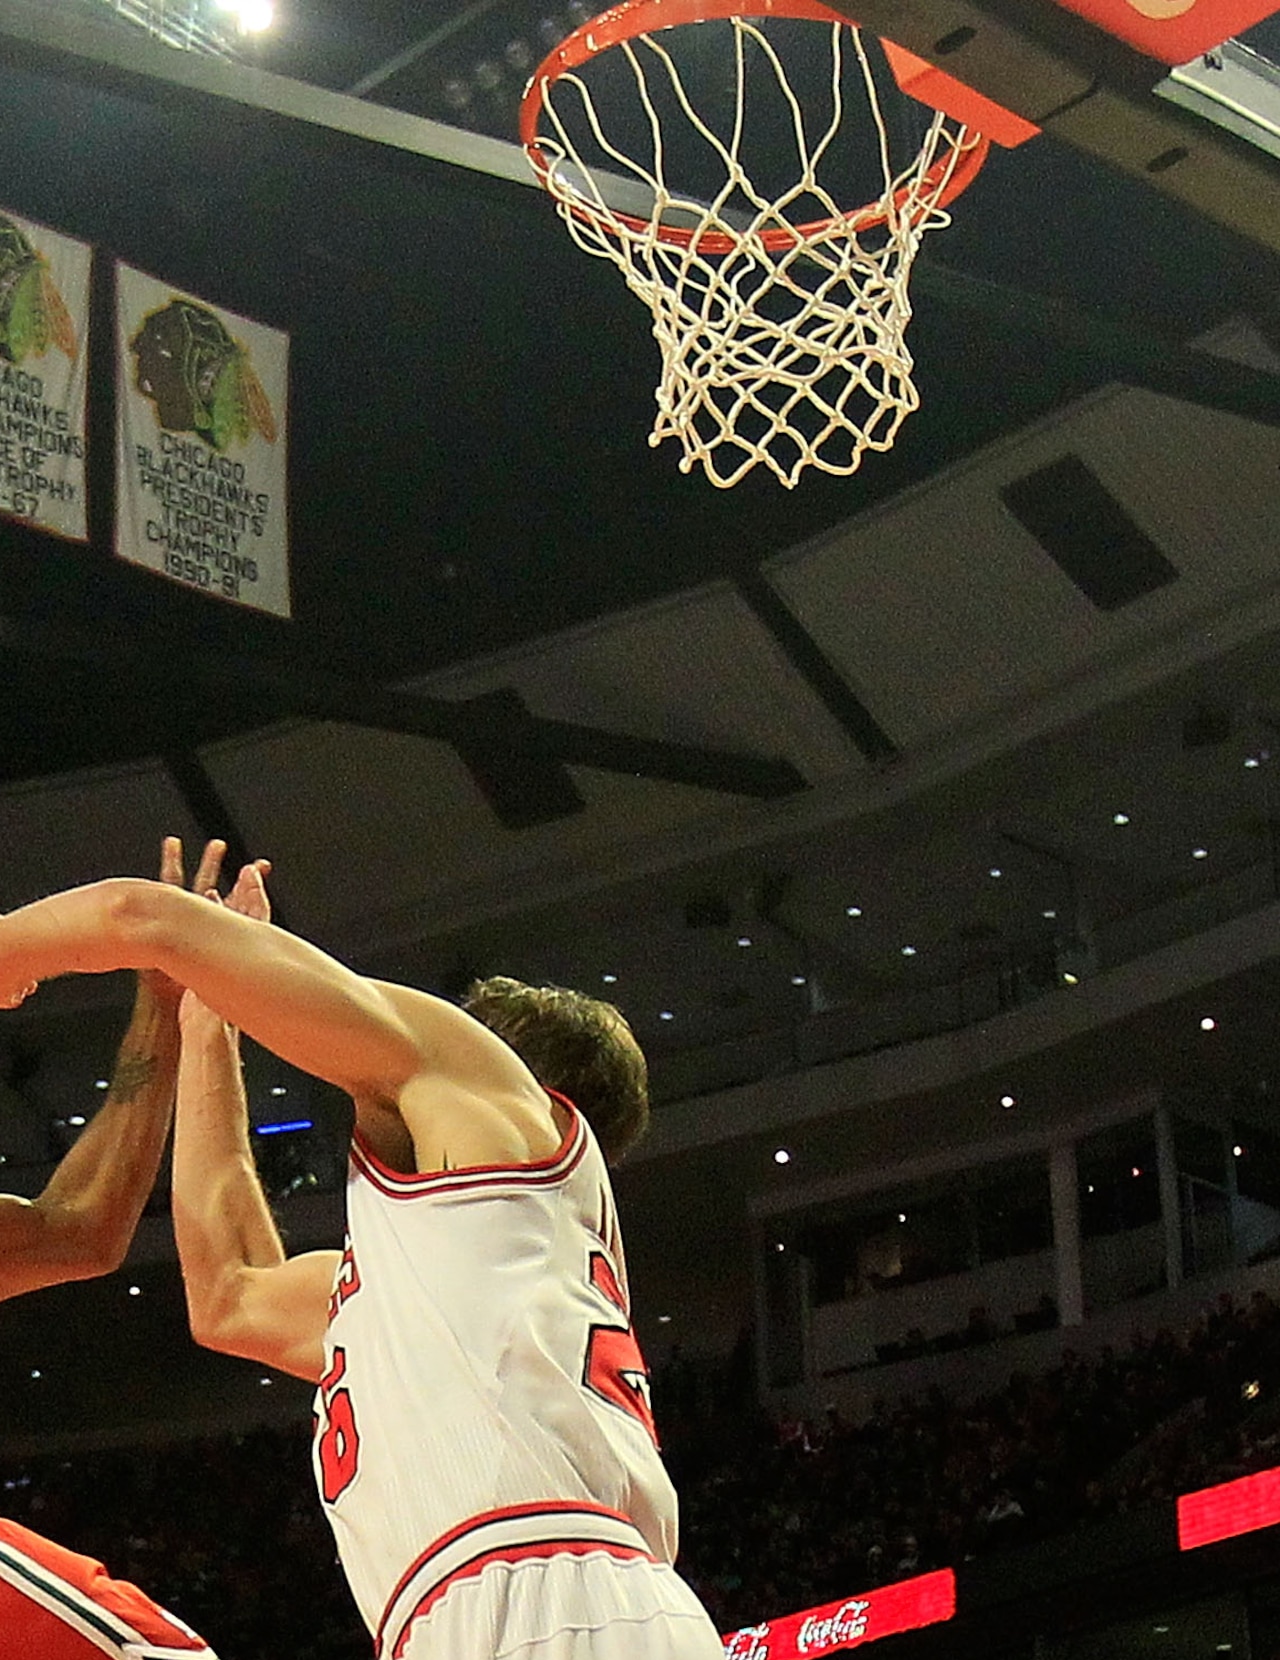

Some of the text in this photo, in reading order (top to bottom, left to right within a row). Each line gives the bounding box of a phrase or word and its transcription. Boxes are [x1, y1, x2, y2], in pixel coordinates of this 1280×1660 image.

[21, 445, 48, 474] OF
[137, 445, 269, 515] BLACKHAWKS
[160, 432, 245, 484] CHICAGO
[146, 519, 258, 583] CHAMPIONS
[162, 502, 240, 552] TROPHY
[164, 551, 240, 599] 1990-91
